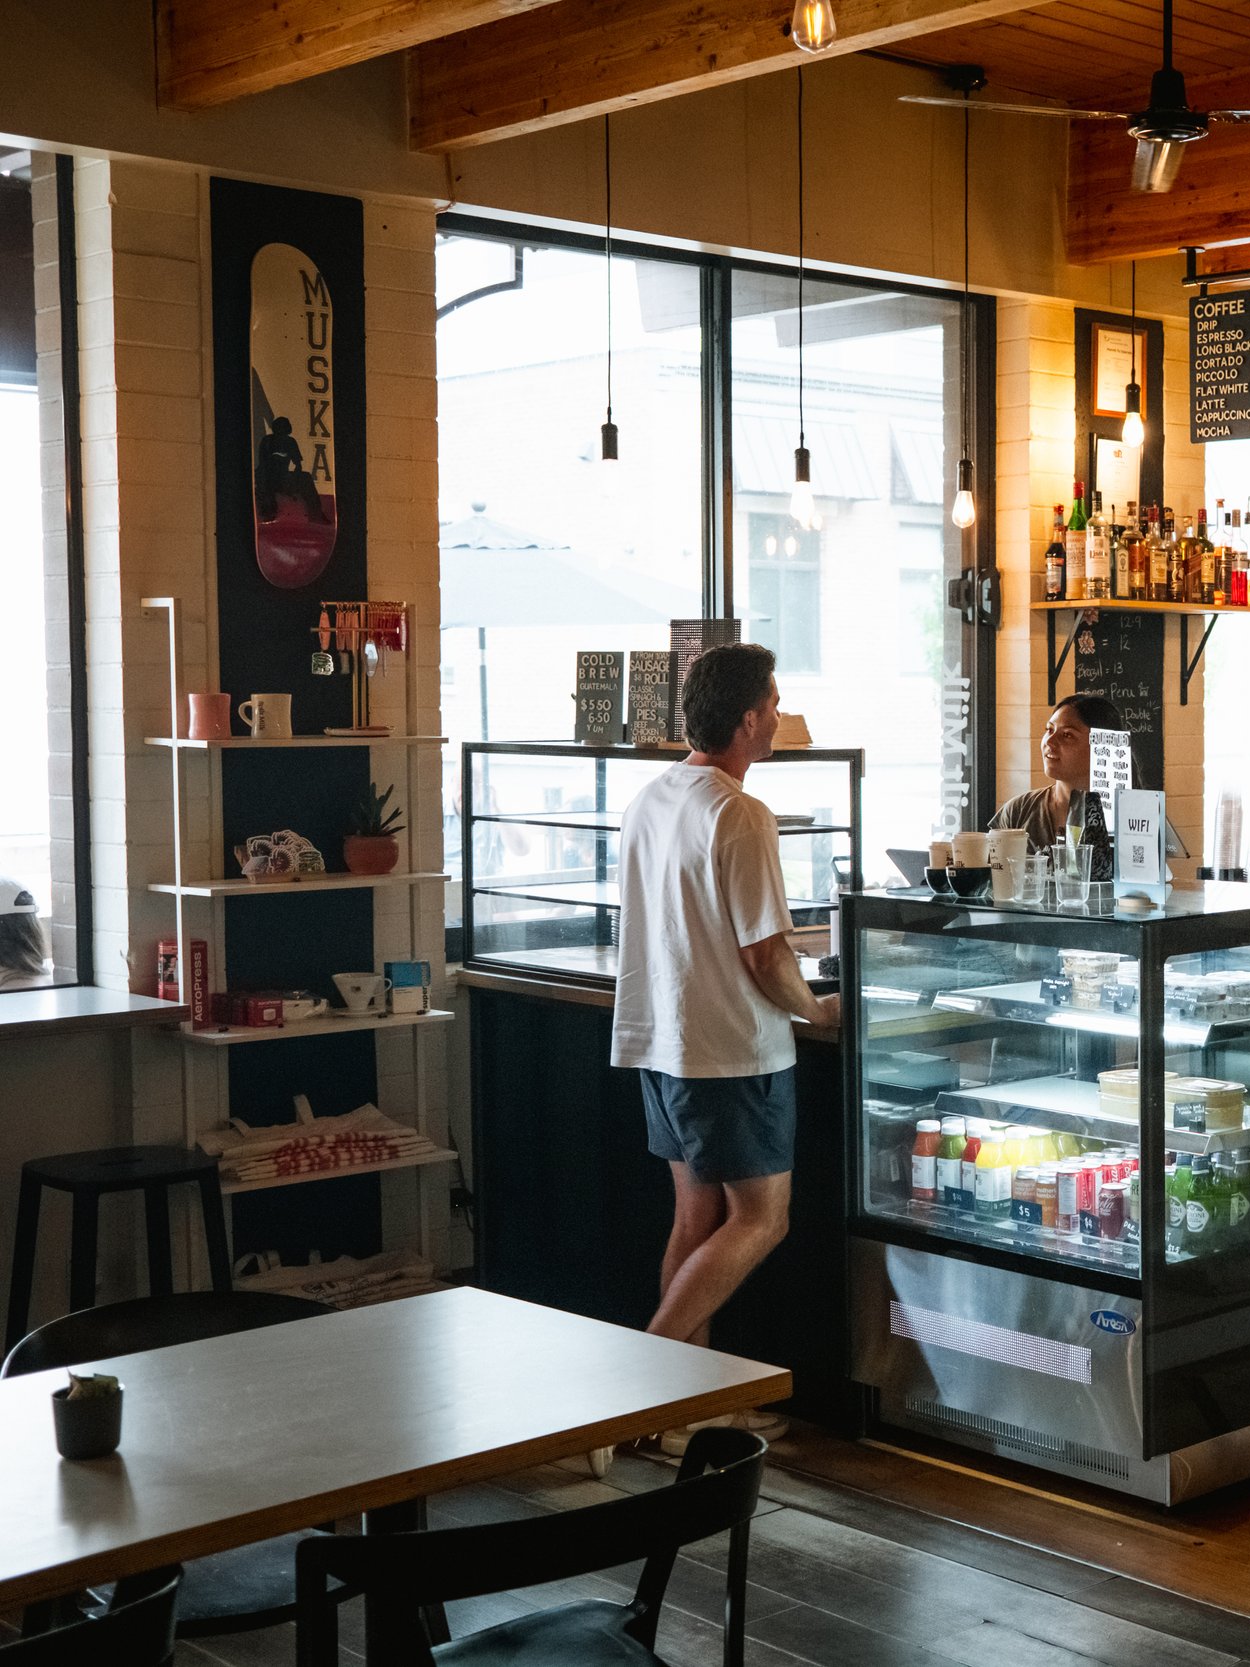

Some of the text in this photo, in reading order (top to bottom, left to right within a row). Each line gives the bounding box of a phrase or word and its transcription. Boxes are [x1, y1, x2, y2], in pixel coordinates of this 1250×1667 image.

[1194, 300, 1245, 319] COFFEE
[1197, 321, 1217, 331] DRIP
[1197, 331, 1244, 344] ESPRESSO
[1197, 345, 1223, 356] LONG
[1195, 356, 1243, 369] CORTADO
[299, 270, 332, 482] MUSKA
[1196, 370, 1237, 382] PICCOLO
[1196, 387, 1217, 396] FLAT
[1219, 384, 1248, 394] WHITE
[1196, 399, 1225, 410] LATTE
[1197, 426, 1231, 437] MOCHA
[581, 654, 614, 666] COLD
[579, 667, 619, 679] BREW
[1114, 662, 1123, 674] 13
[1111, 682, 1135, 700] Peru
[637, 709, 656, 720] PIES
[587, 725, 603, 733] YUM
[634, 721, 648, 729] BEEF
[1128, 818, 1150, 833] WIFI
[194, 952, 202, 1022] AeroPress
[1018, 1204, 1030, 1217] $5
